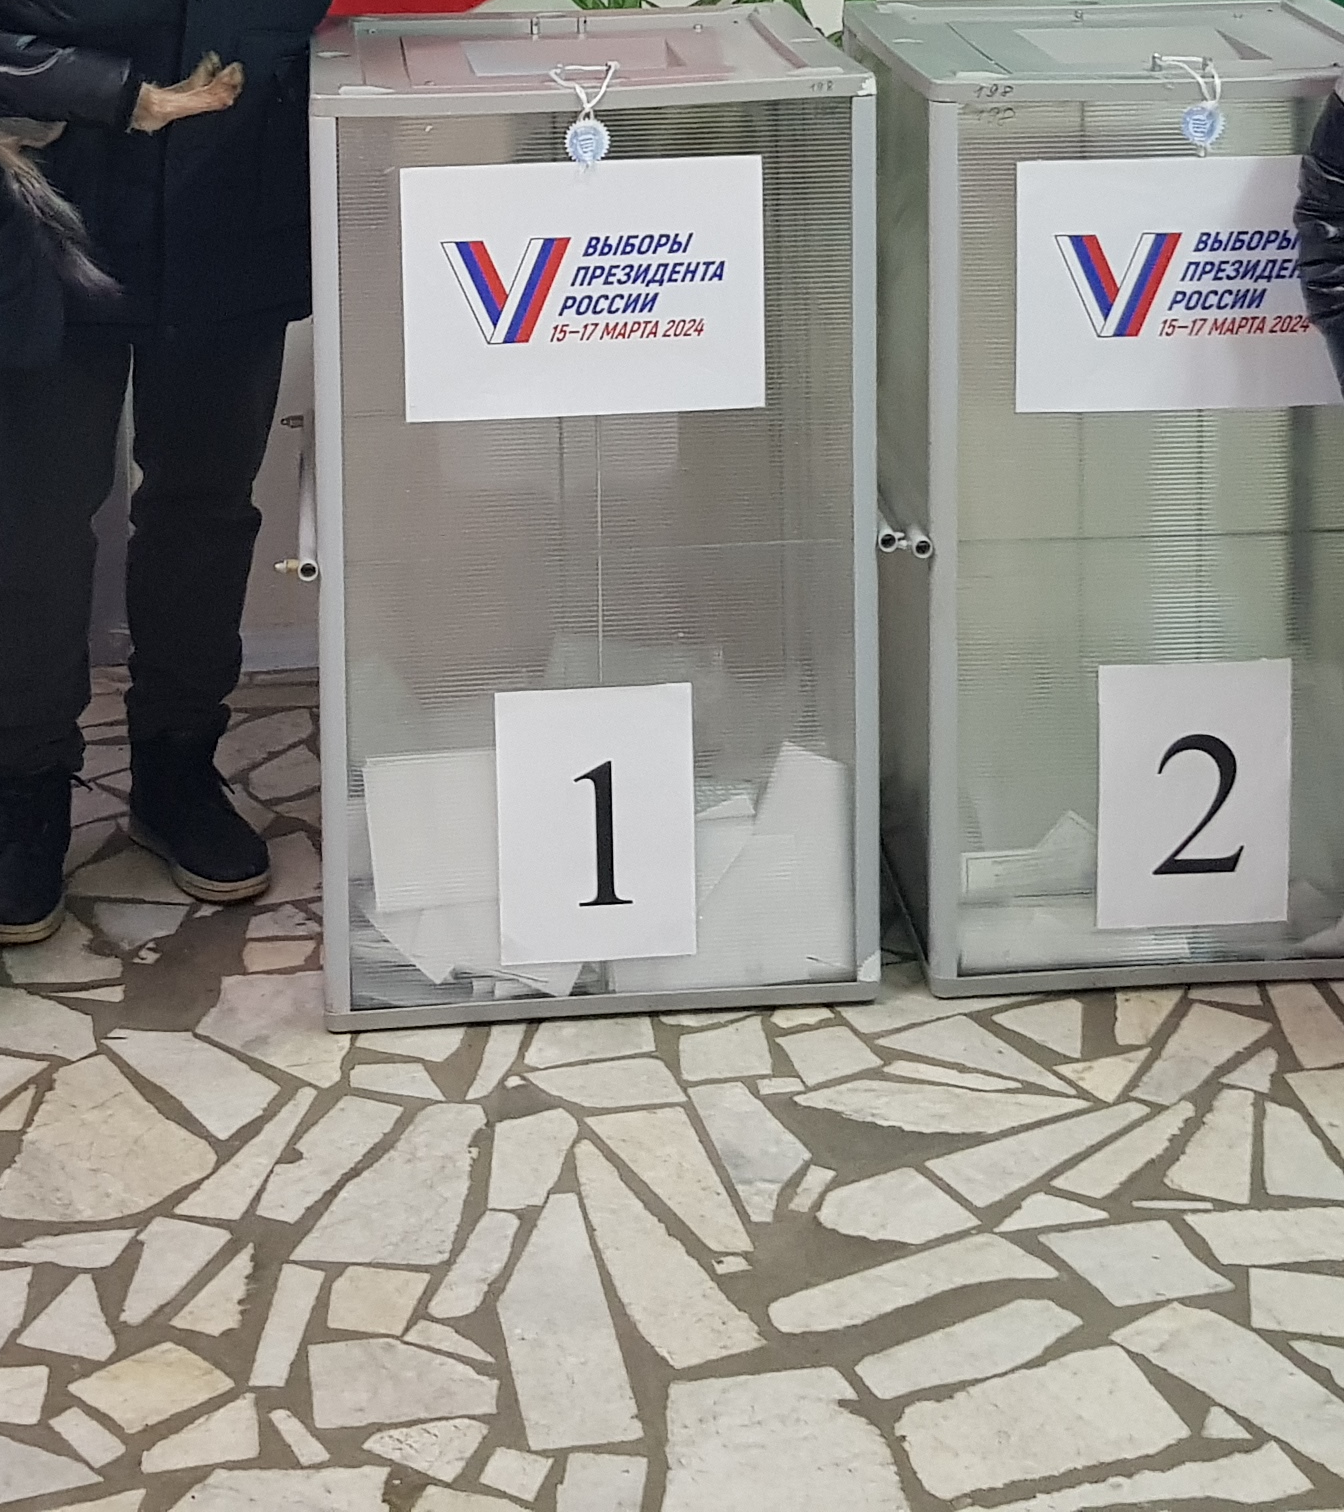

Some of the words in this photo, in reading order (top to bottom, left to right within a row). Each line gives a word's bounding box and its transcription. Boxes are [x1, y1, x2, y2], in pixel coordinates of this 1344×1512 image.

[582, 232, 694, 257] ВЫБОРЫ
[1192, 229, 1300, 253] ВЫБОРЫ
[570, 260, 726, 288] ПРЕЗИДЕНТА
[558, 292, 659, 317] РОССИИ
[1167, 288, 1268, 311] РОССИИ
[599, 319, 659, 341] МАРТА
[662, 318, 705, 338] 2024
[1207, 316, 1267, 336] МАРТА
[1268, 314, 1311, 334] 2024
[1151, 732, 1245, 876] 2
[573, 759, 634, 908] 1
